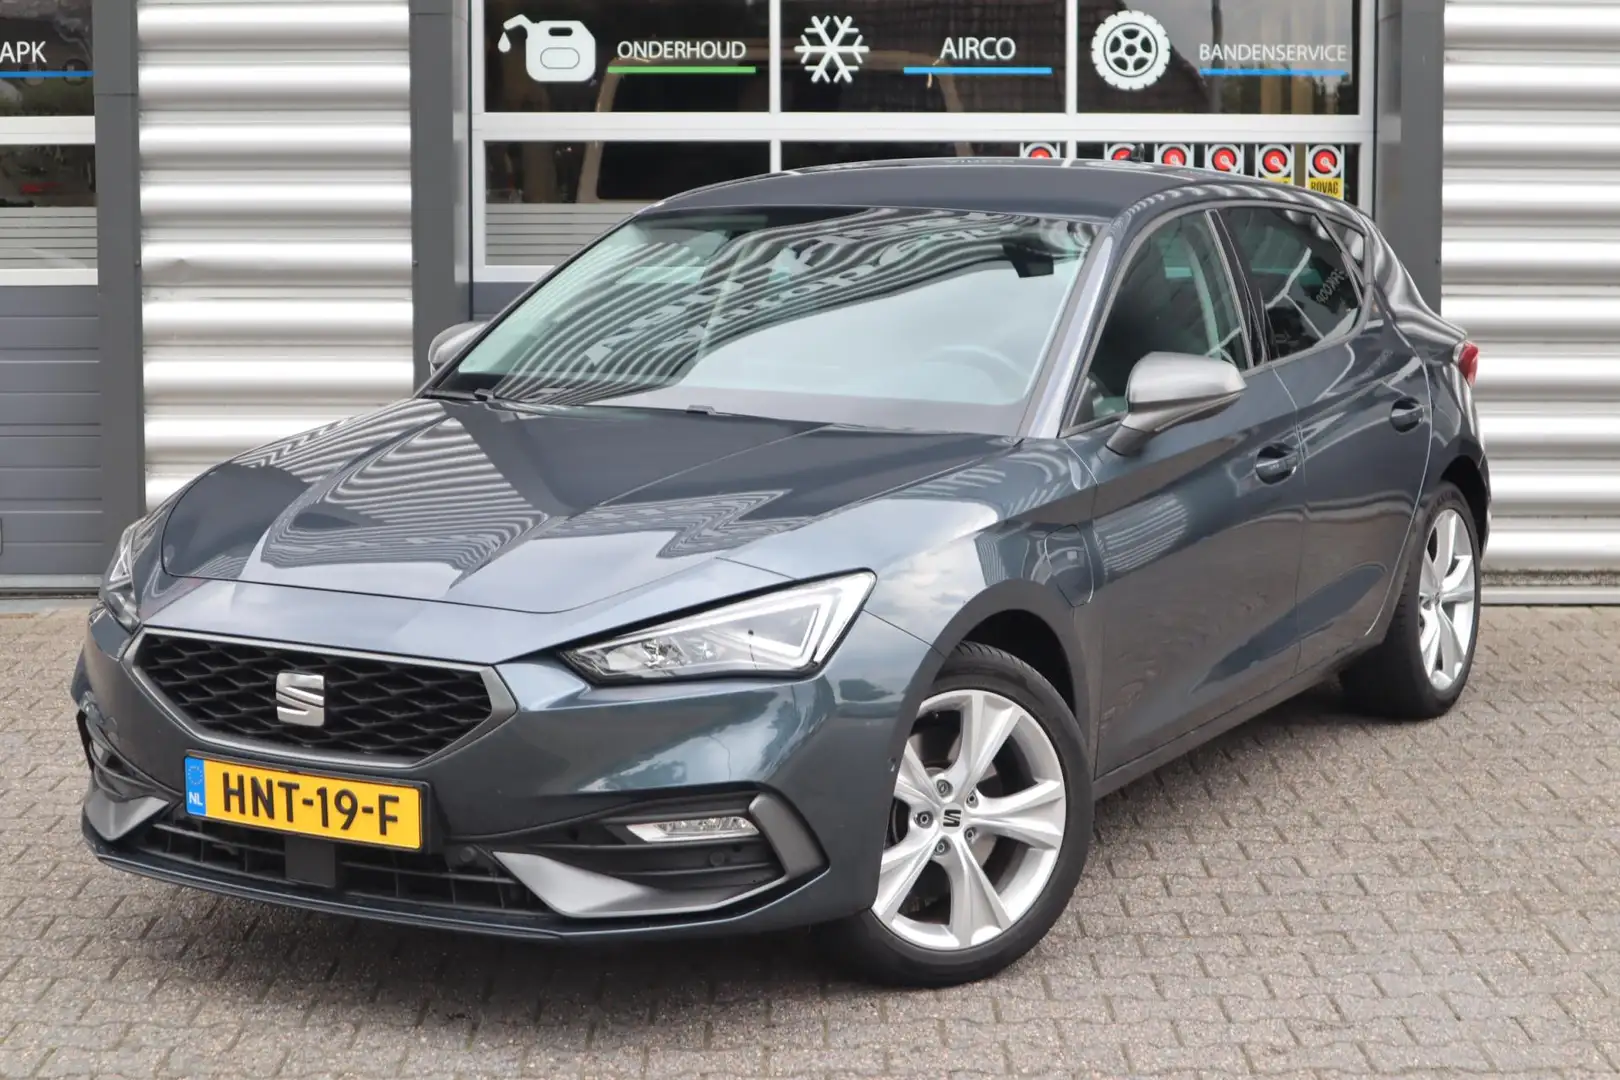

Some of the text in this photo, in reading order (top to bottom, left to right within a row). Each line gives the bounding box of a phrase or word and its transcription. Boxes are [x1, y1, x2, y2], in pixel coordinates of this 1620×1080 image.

[0, 41, 47, 63] APK
[617, 40, 746, 59] ONDERHOUD
[940, 36, 1016, 60] AIRCO
[1199, 43, 1347, 62] BANDENSERVICE
[188, 791, 204, 806] NL
[222, 771, 400, 836] HNT-19-F
